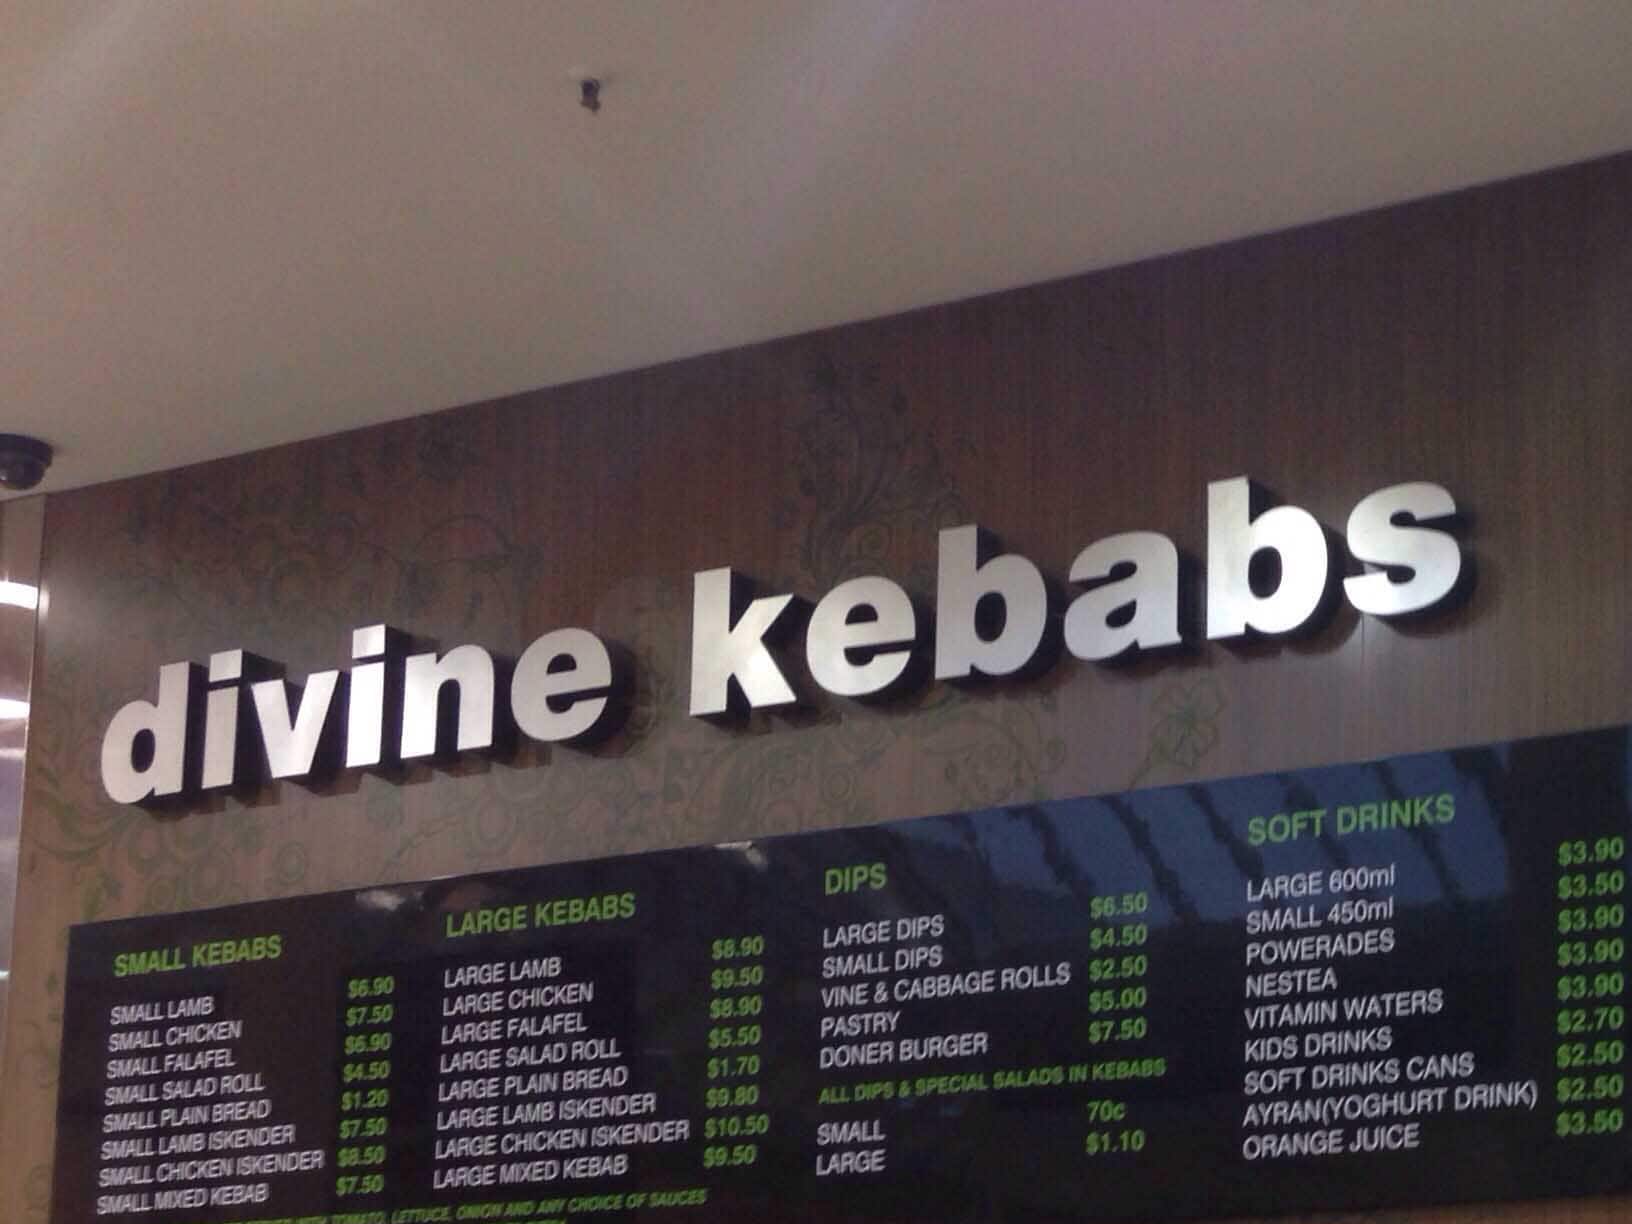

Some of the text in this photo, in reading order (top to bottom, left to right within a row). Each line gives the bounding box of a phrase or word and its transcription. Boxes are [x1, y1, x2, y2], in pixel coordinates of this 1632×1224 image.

[100, 476, 1464, 805] divine kebabs
[1248, 794, 1455, 846] SOFT DRINKS
[1557, 837, 1624, 866] $3.90
[824, 863, 888, 896] DIPS
[1246, 864, 1396, 903] LARGE 600ml
[1557, 870, 1624, 901] $3.50
[446, 893, 636, 938] LARGE KEBABS
[1090, 892, 1148, 918] $6.50
[1246, 897, 1394, 935] SMALL 450ml
[1557, 904, 1624, 934] $3.90
[822, 914, 945, 949] LARGE DIPS
[1089, 924, 1148, 950] $4.50
[1246, 928, 1395, 966] POWERADES
[113, 935, 282, 977] SMALL KEBABS
[711, 936, 765, 960] $8.90
[822, 945, 943, 979] SMALL DIPS
[1556, 938, 1624, 967] $3.90
[444, 957, 562, 988] LARGE LAMB
[711, 966, 764, 990] $9.50
[1089, 956, 1148, 981] $2.50
[1245, 967, 1337, 999] NESTEA
[442, 982, 594, 1017] LARGE CHICKEN
[821, 962, 1072, 1008] VINE & CABBAGE ROLLS
[1089, 987, 1147, 1012] $5.00
[1556, 972, 1624, 1000] $3.90
[110, 996, 215, 1025] SMALL LAMB
[346, 1004, 393, 1027] $7.50
[1244, 988, 1444, 1030] VITAMIN WATERS
[1556, 1007, 1624, 1035] $2.70
[108, 1020, 242, 1052] SMALL CHICKEN
[441, 1013, 589, 1045] LARGE FALAFEL
[709, 1025, 762, 1049] $5.50
[820, 1011, 902, 1039] PASTRY
[1088, 1017, 1147, 1043] $7.50
[440, 1038, 622, 1073] LARGE SALAD ROLL
[819, 1032, 989, 1069] DONER BURGER
[1245, 1027, 1393, 1063] KIDS DRINKS
[1556, 1040, 1624, 1069] $2.50
[106, 1049, 236, 1078] SMALL FALAFEL
[343, 1061, 391, 1083] $4.50
[707, 1056, 761, 1079] $1.70
[1244, 1051, 1475, 1096] SOFT DRINKS CANS
[105, 1073, 266, 1106] SMALL SALAD ROLL
[438, 1066, 629, 1103] LARGE PLAIN BREAD
[819, 1058, 1166, 1105] ALL DIPS & SPECIAL SALADS IN KEBABS
[1556, 1074, 1624, 1103] $2.50
[341, 1089, 390, 1111] $1.20
[436, 1093, 656, 1131] LARGE LAMB ISKENDER
[1087, 1100, 1126, 1122] 70c
[1243, 1080, 1538, 1128] AYRAN(YOGHURT DRINK)
[102, 1099, 271, 1133] SMALL PLAIN BREAD
[339, 1117, 388, 1139] $7.50
[704, 1114, 769, 1138] $10.50
[1555, 1108, 1624, 1137] $3.50
[101, 1124, 296, 1160] SMALL LAMB ISKENDER
[435, 1120, 691, 1160] LARGE CHICKEN ISKENDER
[816, 1120, 886, 1146] SMALL
[1086, 1129, 1145, 1156] $1.10
[1243, 1123, 1420, 1161] ORANGE JUICE
[99, 1150, 325, 1187] SMALL CHICKEN ISKENDER
[433, 1154, 629, 1189] LARGE MIXED KEBAB
[703, 1145, 757, 1168] $9.50
[815, 1150, 886, 1177] LARGE
[96, 1183, 270, 1215] SMALL MIXED KEBAB
[336, 1175, 385, 1196] $7.50
